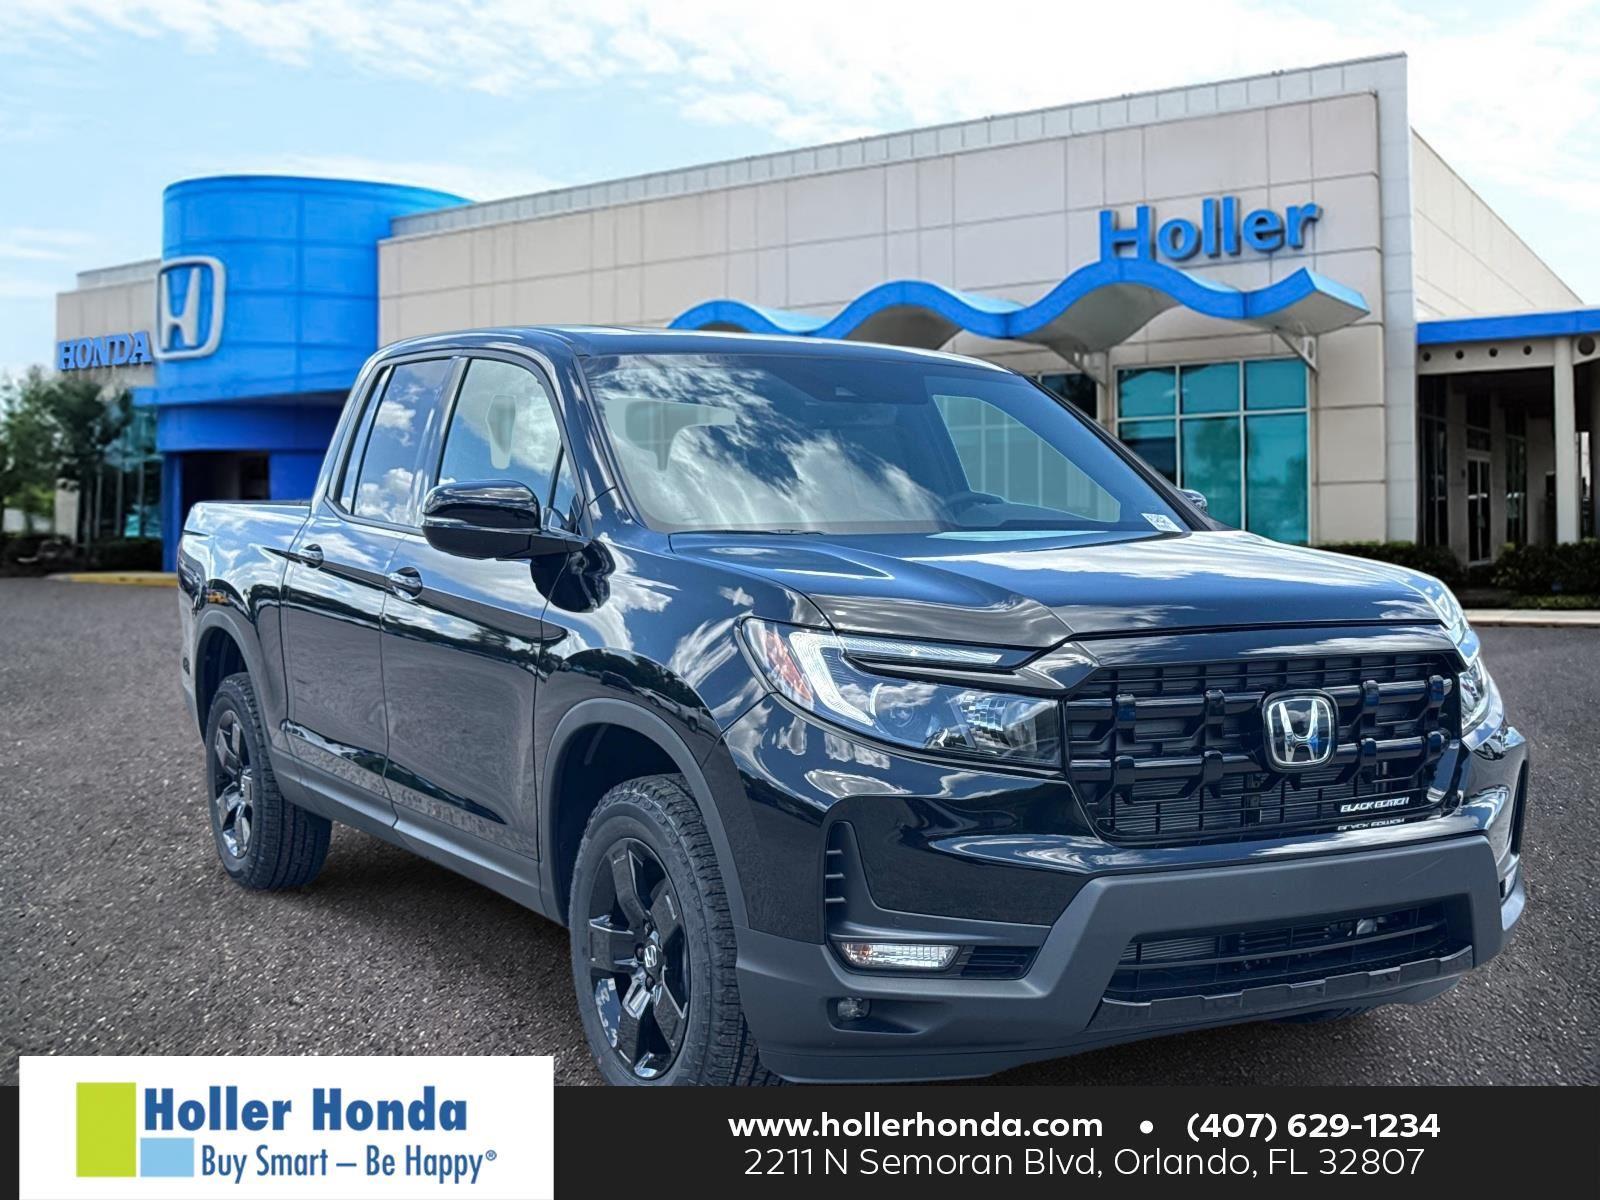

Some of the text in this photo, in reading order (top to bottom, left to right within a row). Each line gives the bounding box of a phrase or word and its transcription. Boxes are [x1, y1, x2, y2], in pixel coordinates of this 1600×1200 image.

[1099, 196, 1323, 262] Holler
[58, 331, 152, 370] HONDA
[1340, 801, 1375, 812] BLACK
